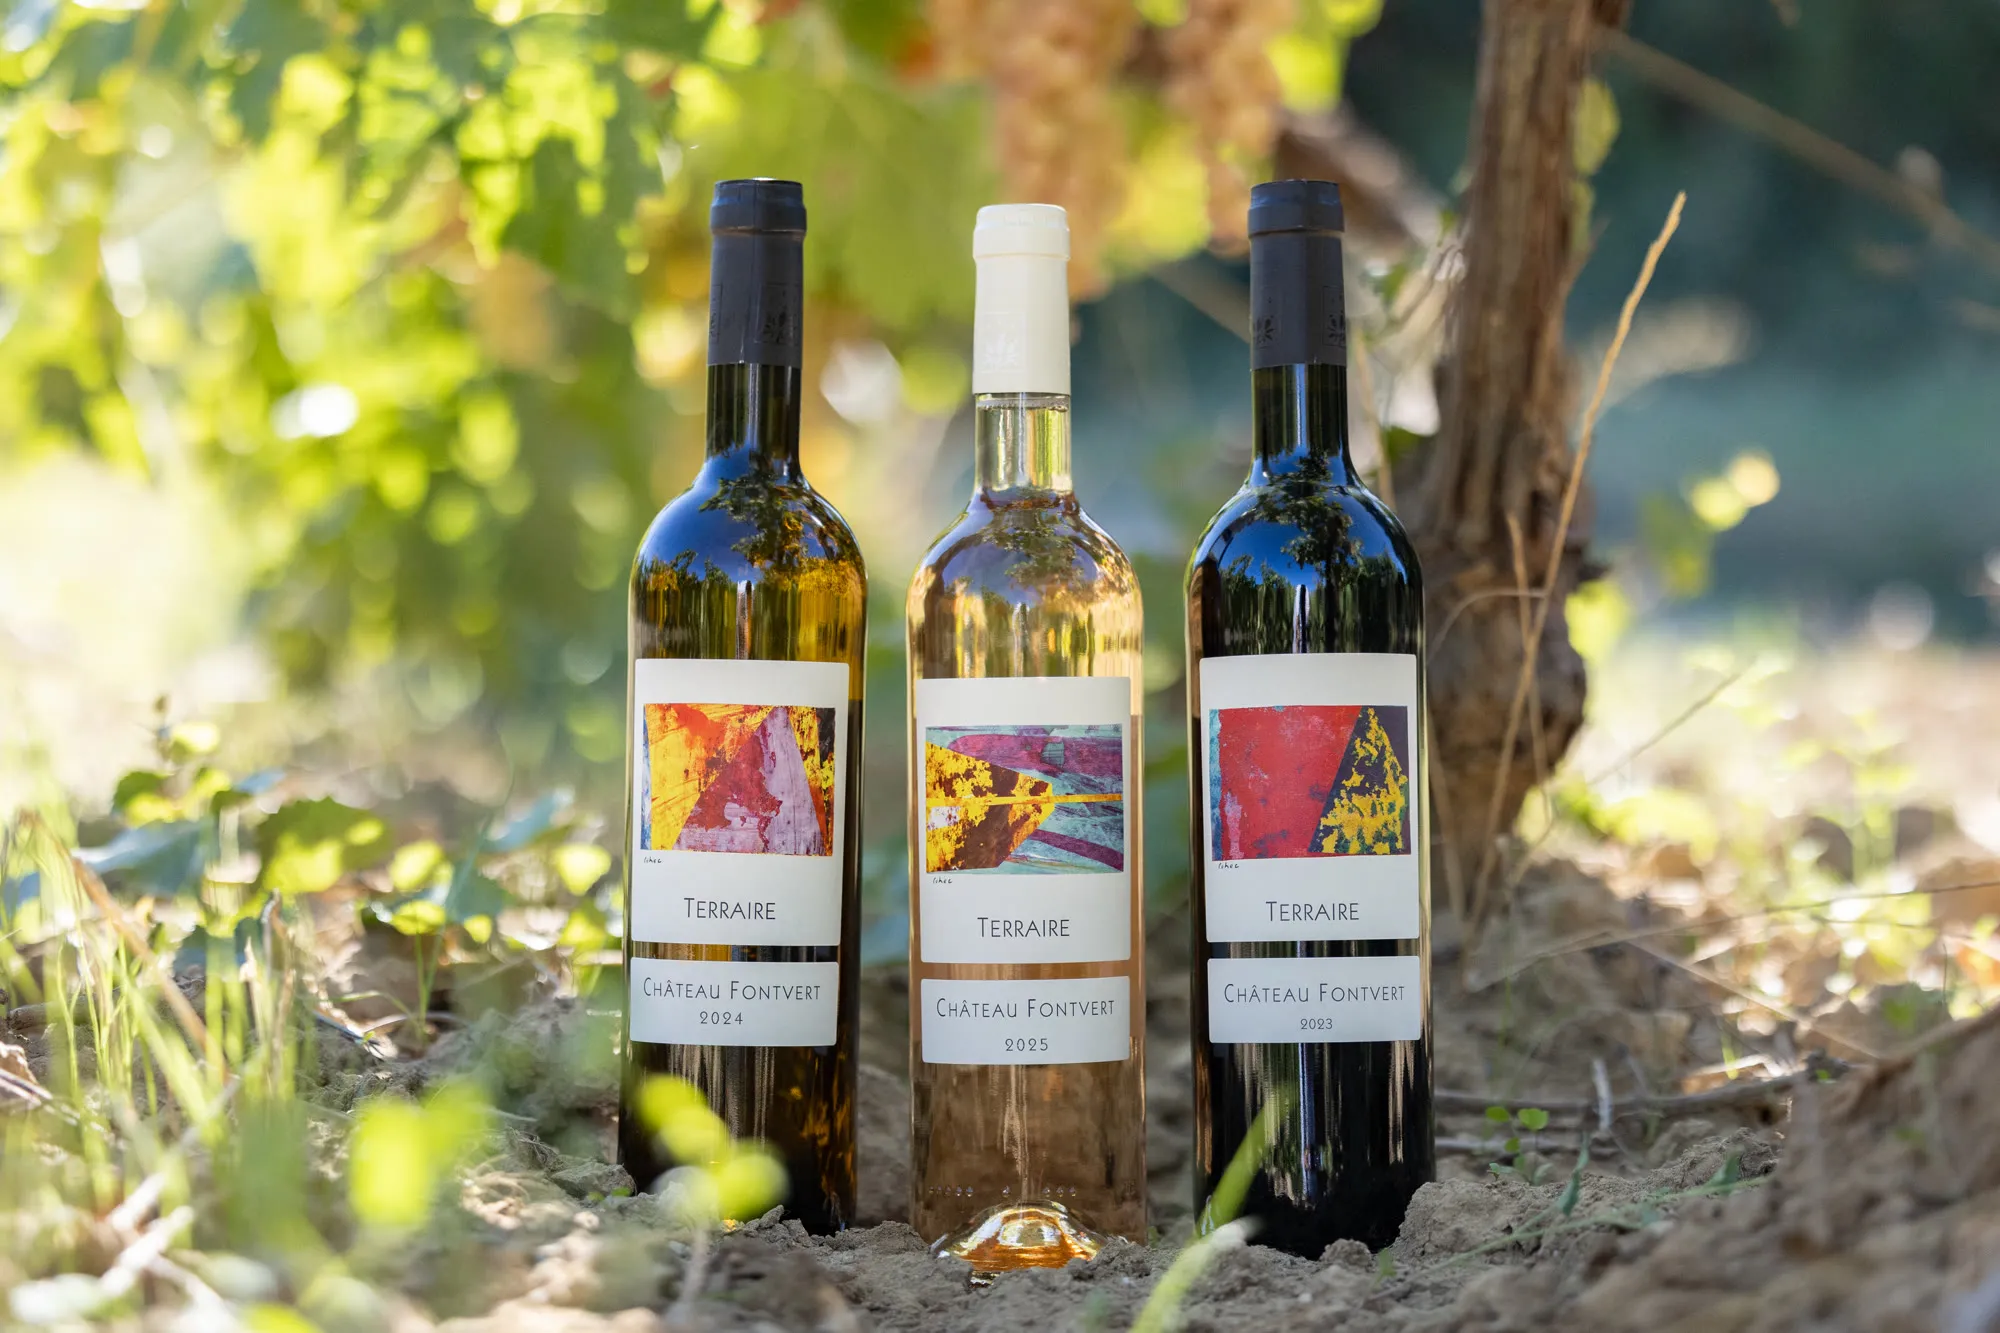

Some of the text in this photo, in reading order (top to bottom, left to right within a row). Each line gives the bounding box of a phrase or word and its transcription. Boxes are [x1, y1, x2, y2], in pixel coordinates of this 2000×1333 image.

[683, 897, 776, 920] TERRAIRE
[1265, 901, 1360, 922] TERRAIRE
[976, 917, 1070, 938] TERRAIRE
[643, 977, 821, 1001] CHÂTEAU FONTVERT
[1223, 983, 1405, 1003] CHÂTEAU FONTVERT
[700, 1011, 744, 1025] 2024
[936, 997, 1115, 1018] CHÂTEAU FONTVERT
[1300, 1018, 1333, 1030] 2023
[1005, 1038, 1049, 1052] 2025
